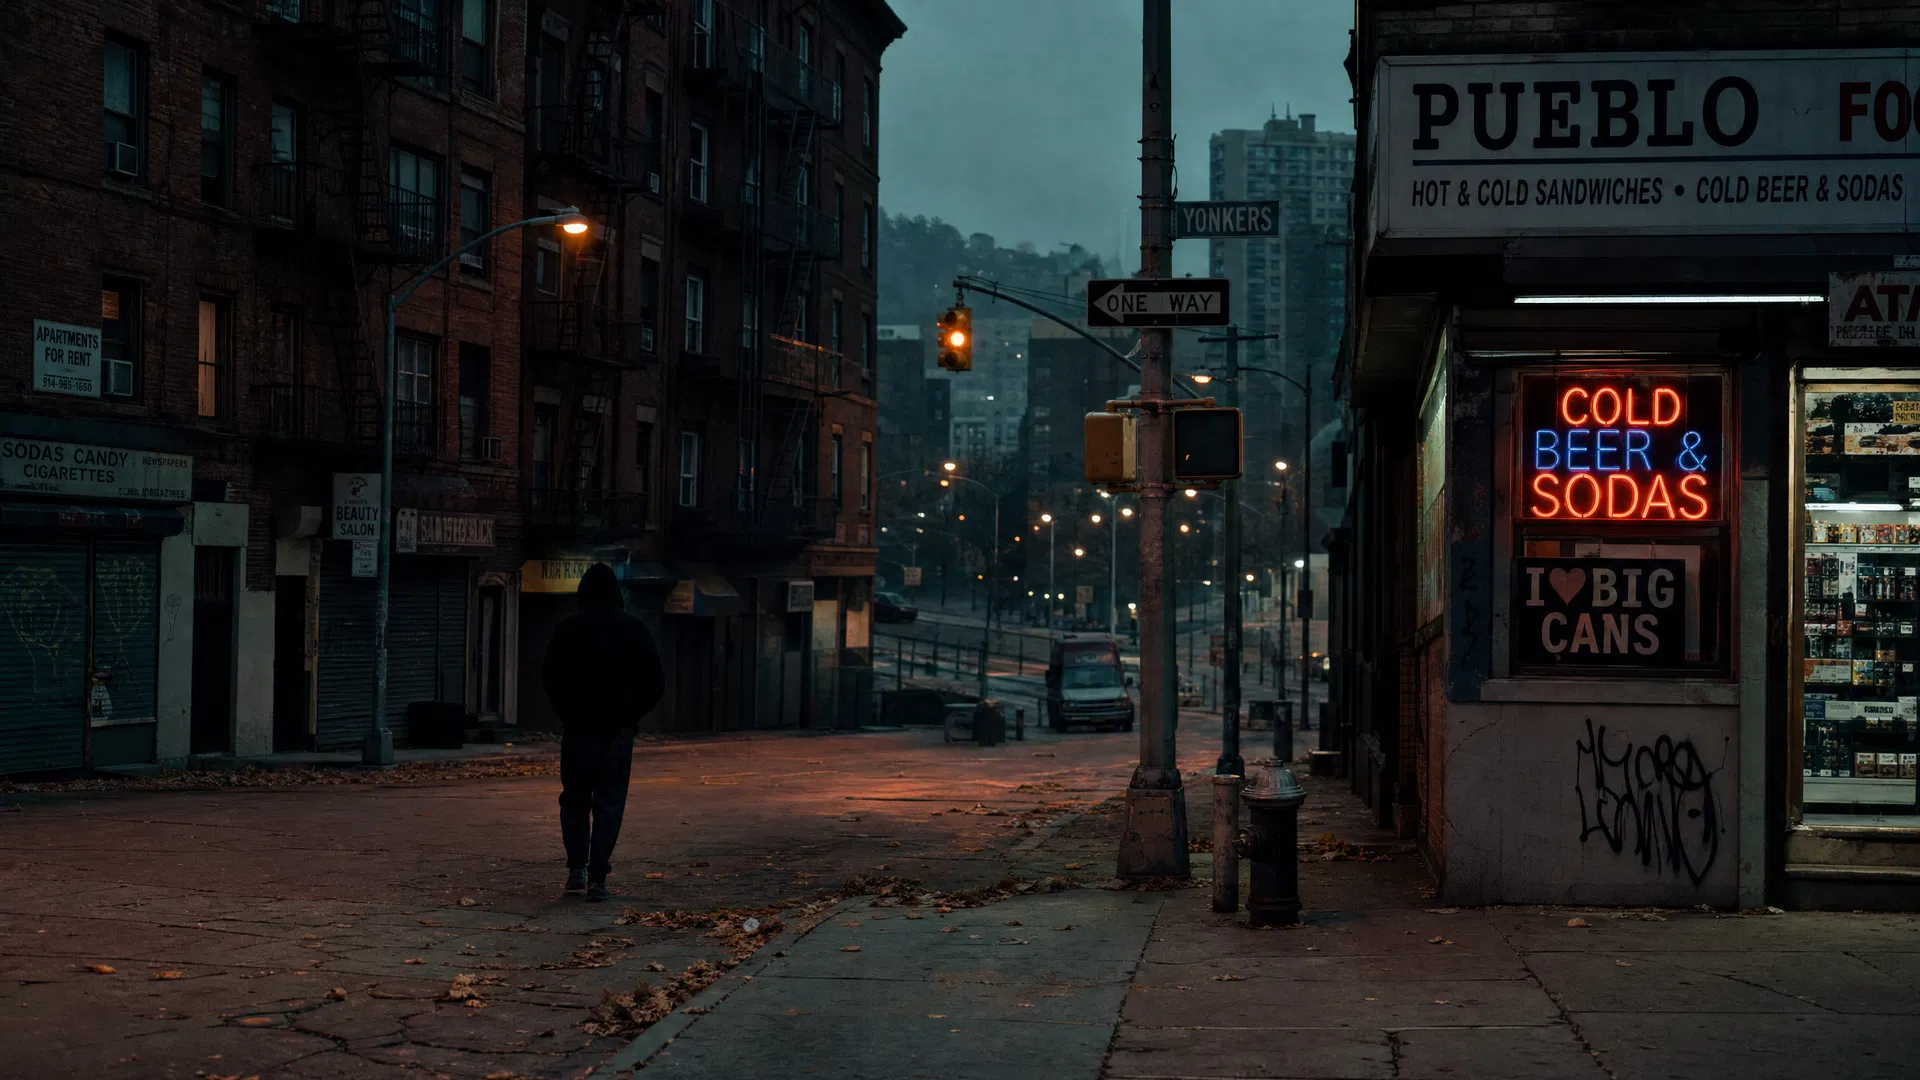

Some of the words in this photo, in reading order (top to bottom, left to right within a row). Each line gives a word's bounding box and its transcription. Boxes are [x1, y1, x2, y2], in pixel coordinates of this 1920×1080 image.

[1412, 75, 1758, 150] PUEBLO
[1839, 80, 1920, 142] FO
[1412, 180, 1451, 206] HOT
[1457, 180, 1470, 206] &
[1478, 179, 1529, 206] COLD
[1535, 177, 1663, 205] SANDWICHES
[1696, 175, 1749, 204] COLD
[1756, 175, 1809, 203] BEER
[1816, 174, 1829, 202] &
[1836, 173, 1903, 202] SODAS
[1183, 206, 1272, 233] YONKERS
[1107, 294, 1147, 312] ONE
[1169, 294, 1212, 312] WAY
[36, 326, 99, 349] APARTMENTS
[45, 348, 64, 363] FOR
[68, 350, 91, 367] RENT
[1562, 387, 1680, 426] COLD
[2, 442, 64, 462] SODAS
[74, 448, 128, 467] CANDY
[142, 456, 188, 468] NEWSPAPERS
[1535, 429, 1651, 471] BEER
[1677, 431, 1708, 471] &
[23, 464, 115, 483] CIGARETTES
[1531, 473, 1708, 519] SODAS
[336, 506, 379, 520] BEAUTY
[340, 523, 375, 536] SALON
[1526, 567, 1545, 606] I
[1592, 568, 1675, 608] BIG
[1541, 612, 1659, 654] CANS
